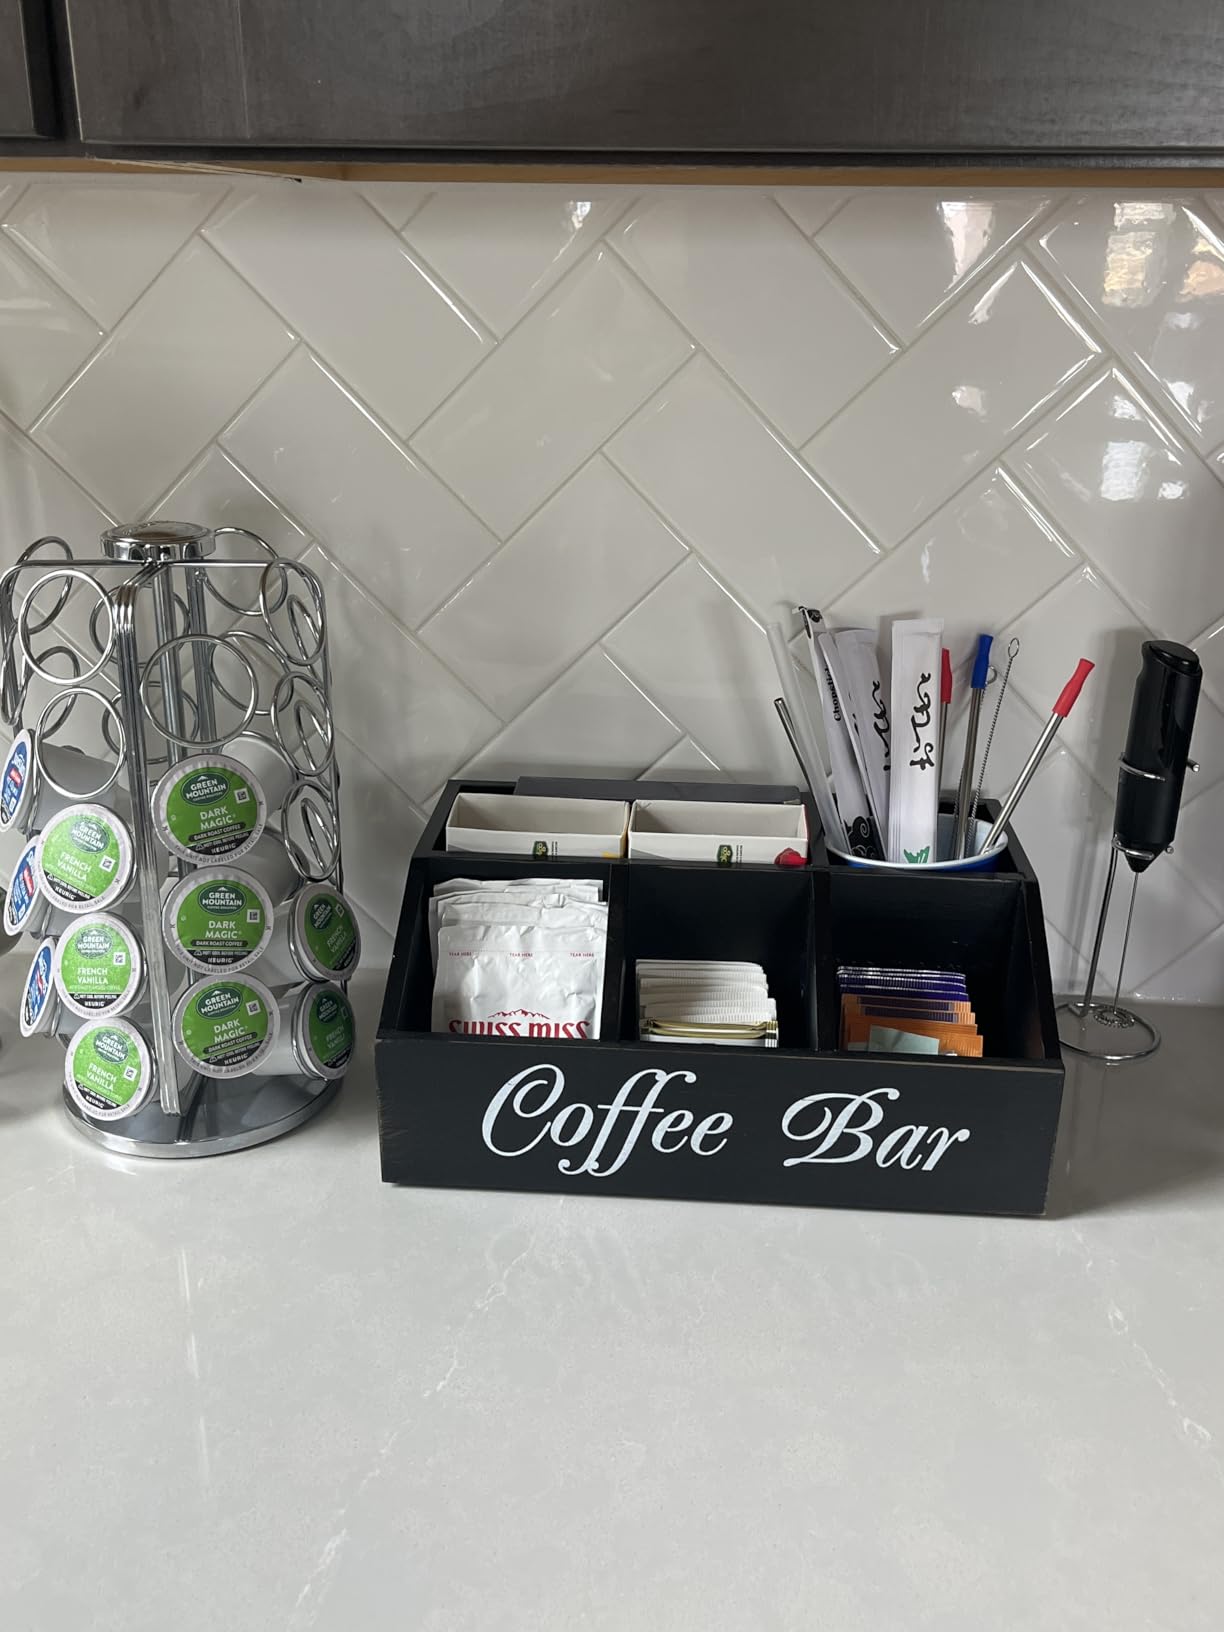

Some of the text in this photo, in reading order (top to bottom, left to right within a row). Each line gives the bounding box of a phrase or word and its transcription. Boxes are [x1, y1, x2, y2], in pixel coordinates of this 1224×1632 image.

[186, 784, 226, 799] MOUNTAIN
[191, 779, 218, 790] GREEN
[200, 806, 228, 820] DARK
[80, 825, 101, 839] GREEN
[208, 829, 223, 837] ROAST
[223, 824, 240, 833] COFFEE
[72, 830, 104, 848] MOUNTAIN
[211, 843, 236, 854] KEURIG
[57, 860, 87, 880] VANILLA
[61, 852, 91, 872] FRENCH
[201, 997, 239, 1014] MOUNTAIN
[205, 993, 231, 1005] GREEN
[214, 1019, 240, 1033] DARK
[96, 1041, 125, 1059] MOUNTAIN
[103, 1036, 123, 1049] GREEN
[208, 1034, 252, 1052] DARK ROAST COFFEE
[89, 1063, 117, 1082] FRENCH
[87, 1071, 114, 1091] VANILLA
[482, 1064, 970, 1177] Coffee Bar
